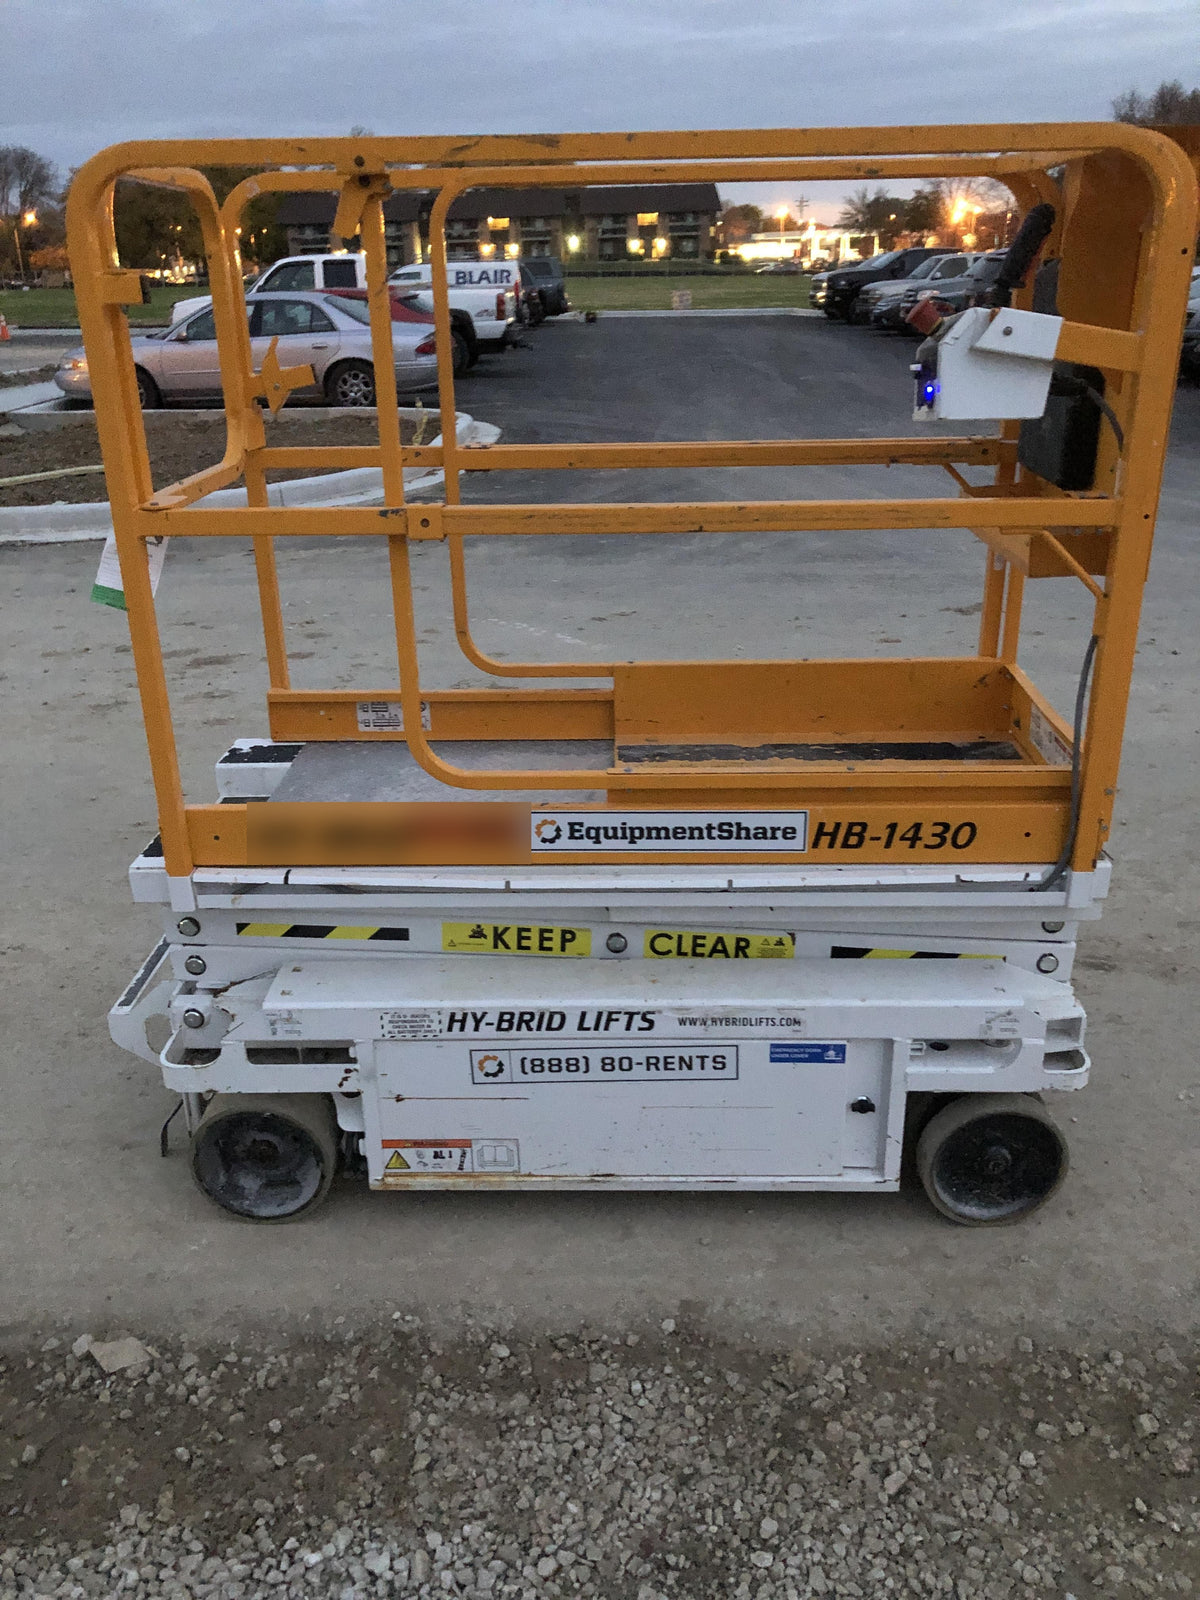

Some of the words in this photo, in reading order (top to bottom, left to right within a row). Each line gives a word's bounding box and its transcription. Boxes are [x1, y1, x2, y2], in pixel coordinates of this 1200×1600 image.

[455, 270, 511, 284] BLAIR
[567, 821, 797, 845] EquipmentShare
[811, 821, 977, 849] HB-1430
[492, 926, 577, 952] KEEP
[649, 933, 751, 959] CLEAR
[447, 1011, 565, 1032] HY-BRID
[577, 1010, 656, 1031] LIFTS
[678, 1017, 801, 1027] WWW.HYBRIDLIFTS.COM
[520, 1056, 590, 1075] (888)
[601, 1054, 727, 1072] 80-RENTS
